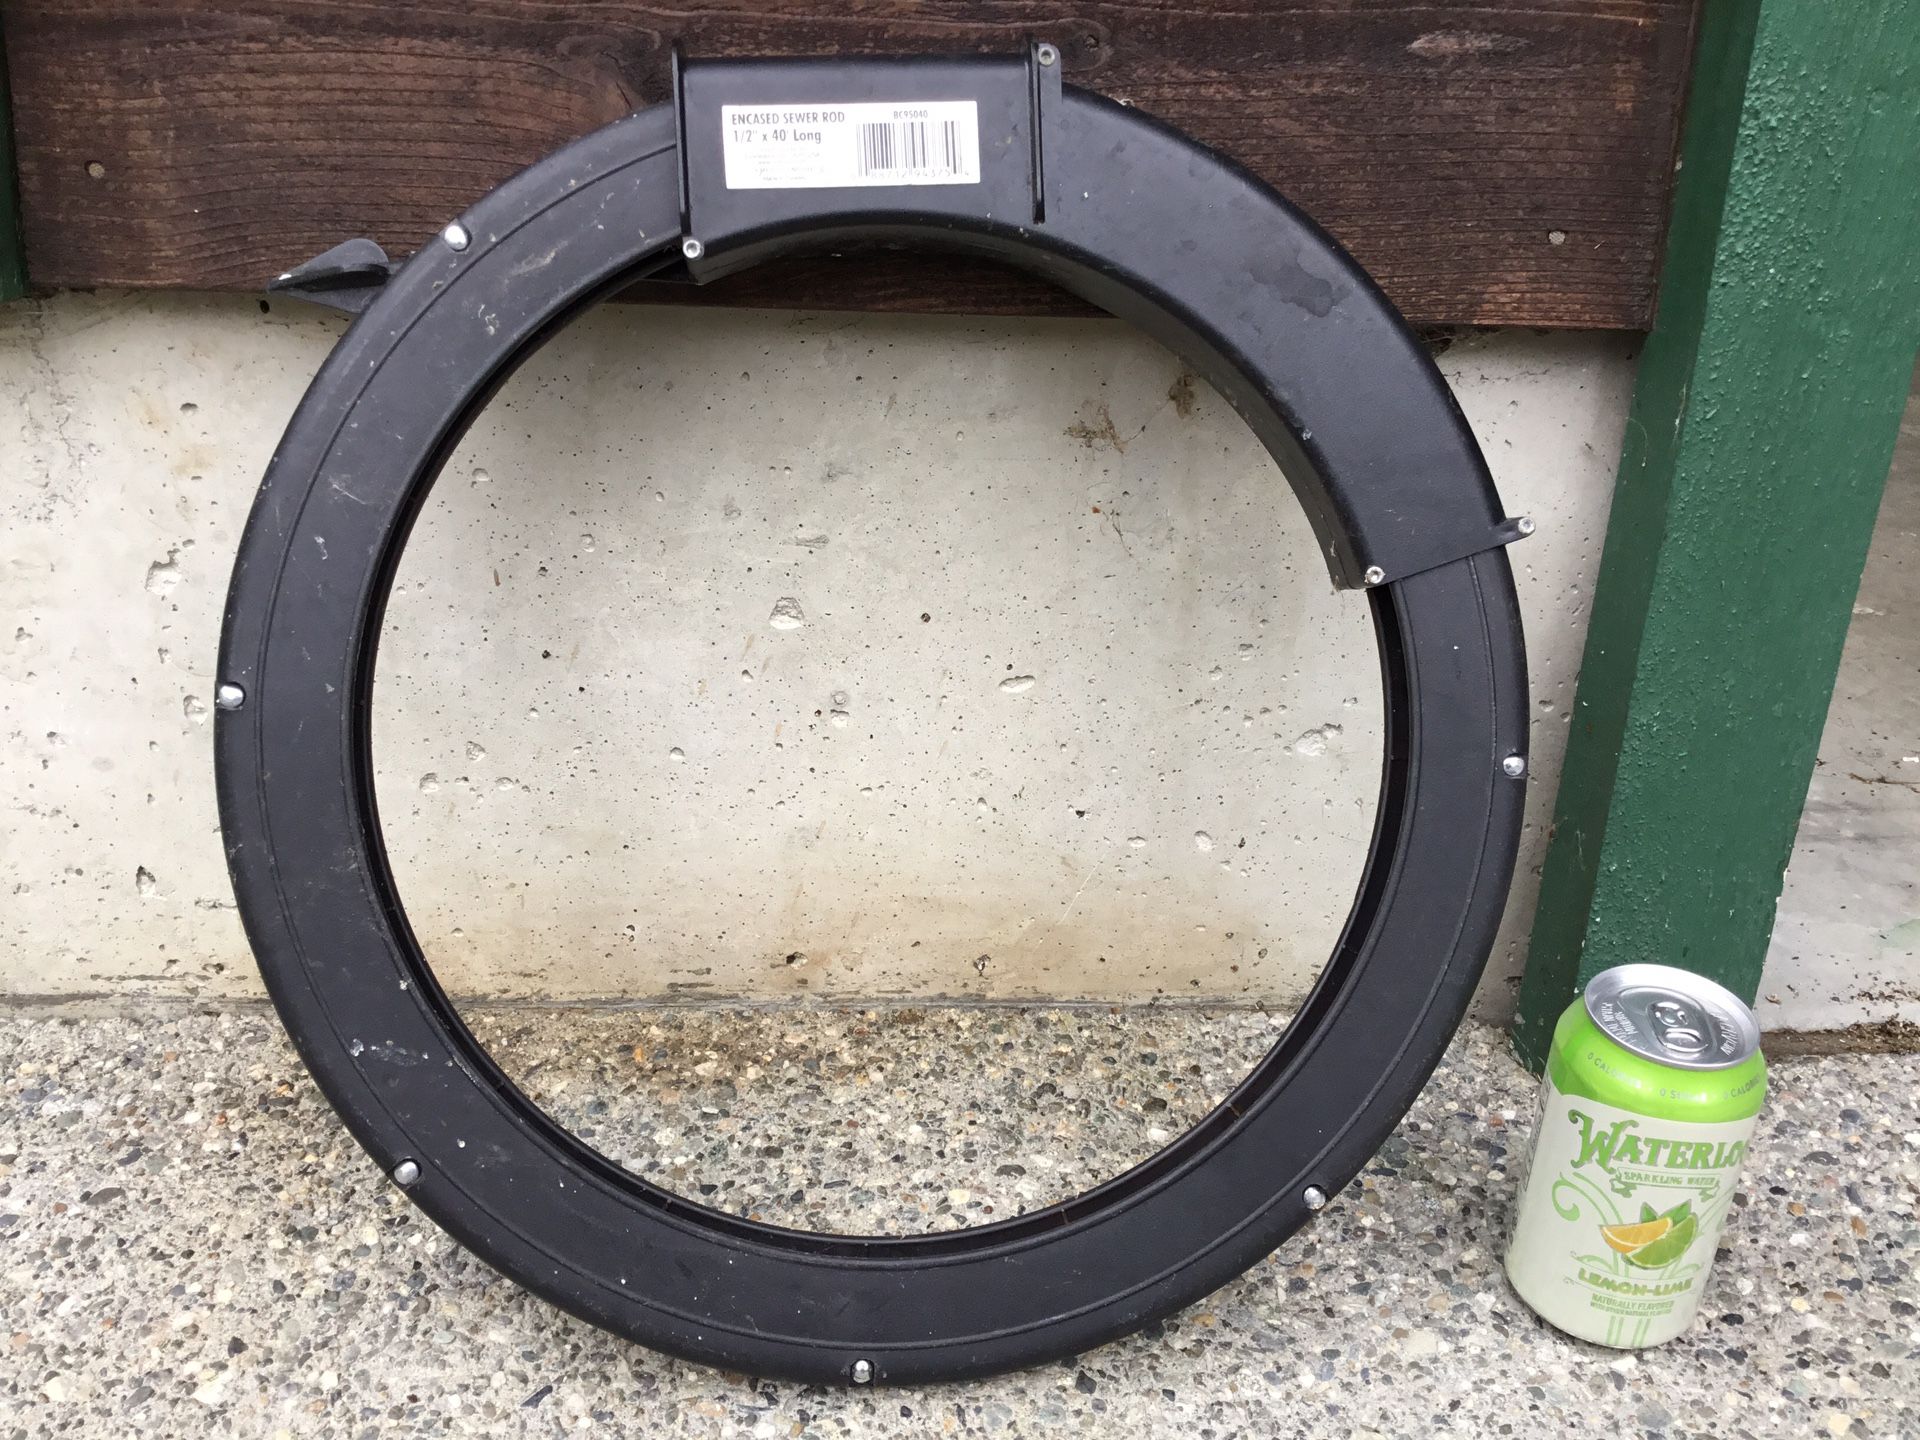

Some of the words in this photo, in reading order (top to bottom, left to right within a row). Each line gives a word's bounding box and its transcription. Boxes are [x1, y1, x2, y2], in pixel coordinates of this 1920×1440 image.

[731, 112, 780, 125] ENCASED
[783, 112, 818, 124] SEWER
[822, 111, 845, 123] ROD
[893, 109, 929, 120] BC95040
[762, 133, 768, 142] x
[793, 128, 821, 144] Long
[1594, 1057, 1642, 1089] CALO
[1568, 1109, 1750, 1174] WATERLO
[1624, 1171, 1683, 1185] SPARKLING
[1578, 1267, 1694, 1296] LEMON-LIME
[1591, 1293, 1637, 1310] NATURALLY
